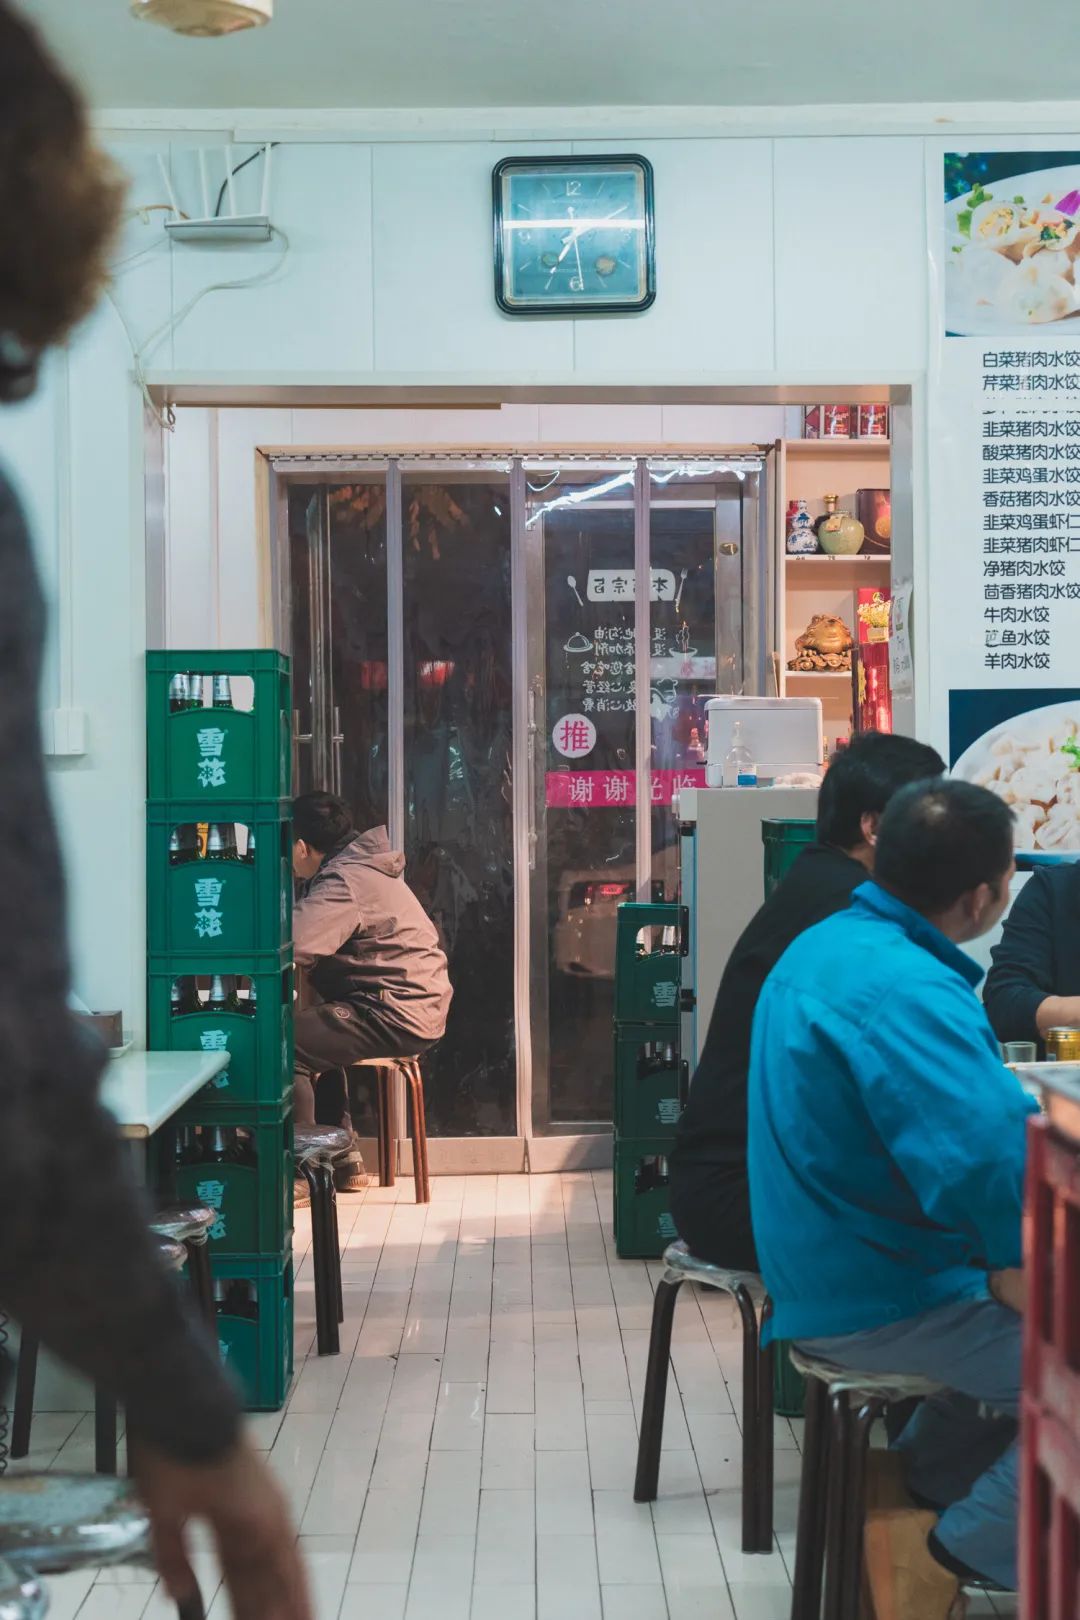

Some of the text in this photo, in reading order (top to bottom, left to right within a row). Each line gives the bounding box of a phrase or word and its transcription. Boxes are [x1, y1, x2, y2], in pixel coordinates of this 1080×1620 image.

[566, 180, 582, 196] 12
[982, 351, 1080, 368] 白菜猪肉水饺
[982, 374, 1080, 391] 芹菜猪肉水饺
[982, 420, 1080, 437] 韭菜猪肉水饺
[982, 444, 1080, 461] 酸菜猪肉水饺
[982, 467, 1080, 484] 韭菜鸡蛋水饺
[982, 491, 1080, 507] 香菇猪肉水饺
[983, 513, 1080, 530] 韭菜鸡蛋虾仁
[983, 537, 1080, 553] 韭菜猪肉虾仁
[983, 560, 1066, 577] 净猪肉水饺
[984, 583, 1080, 600] 茴香猪肉水饺
[984, 606, 1050, 623] 牛肉水饺
[984, 652, 1050, 670] 羊肉水饺
[560, 720, 590, 751] 推
[196, 727, 226, 788] 雪花
[194, 877, 223, 938] 雪花
